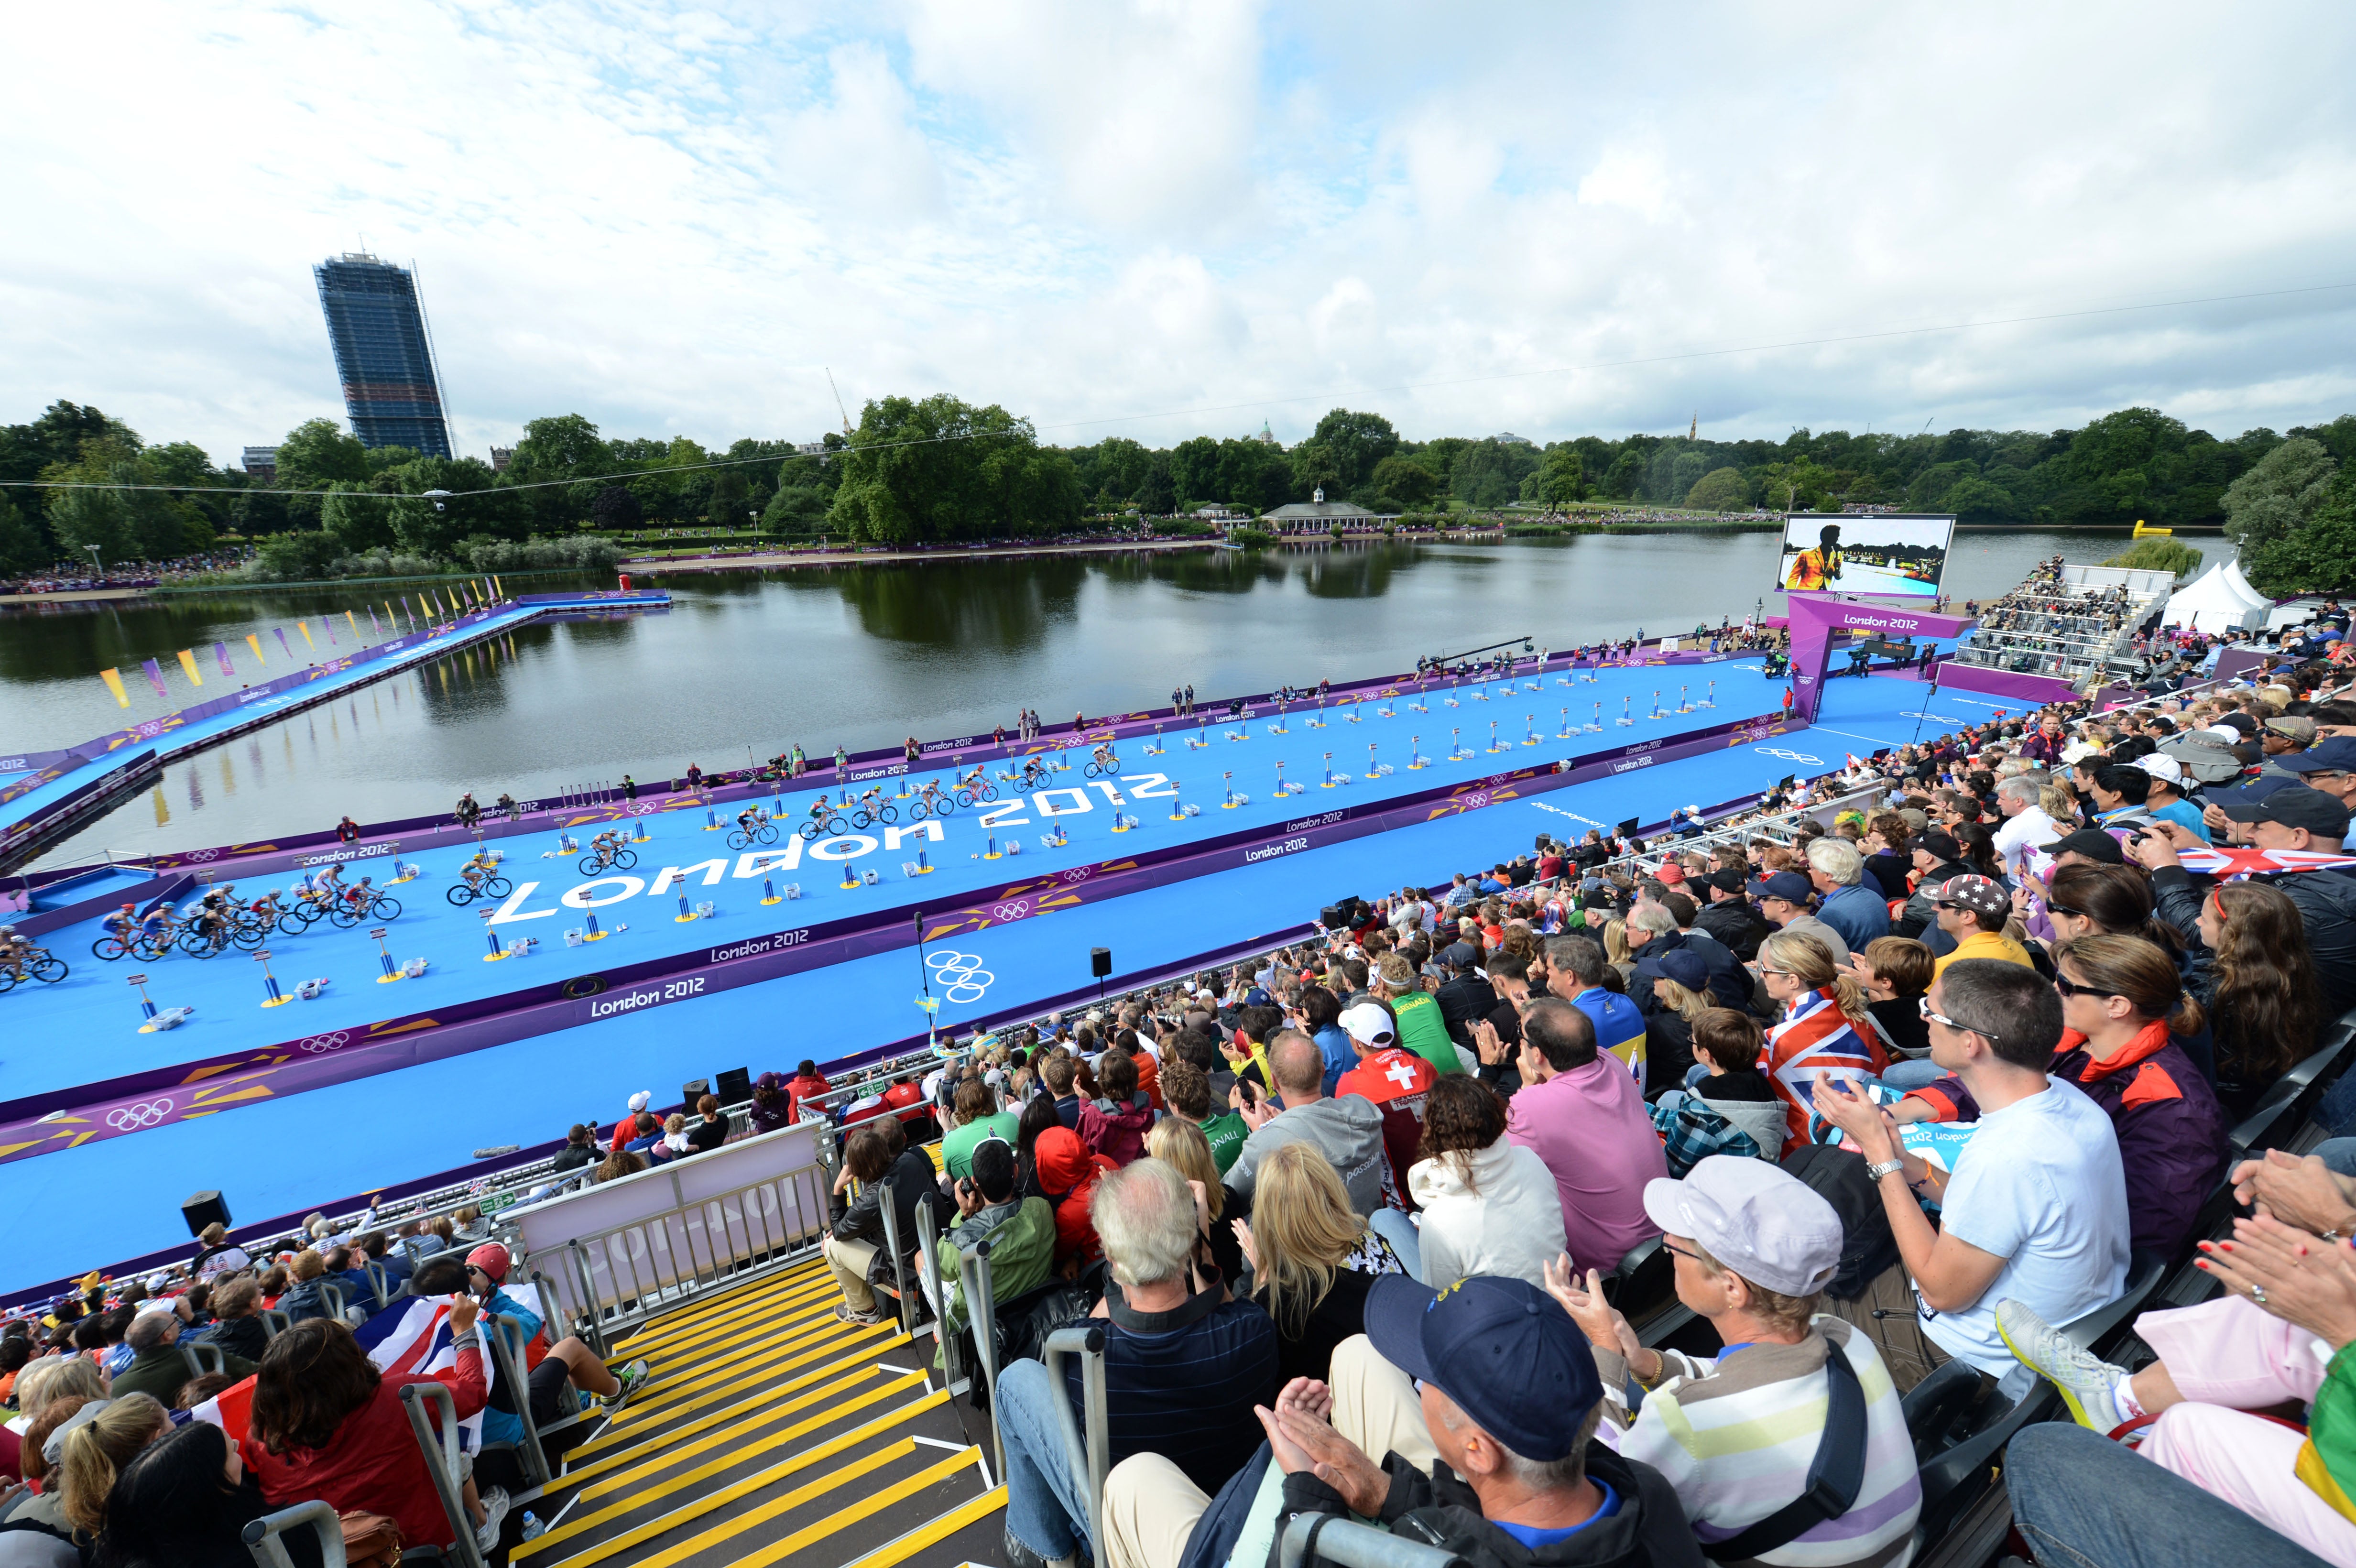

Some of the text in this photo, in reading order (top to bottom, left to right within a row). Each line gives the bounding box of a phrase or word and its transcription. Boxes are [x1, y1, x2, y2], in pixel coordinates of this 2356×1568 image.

[1844, 614, 1918, 630] London 2012
[240, 691, 259, 702] London
[1215, 714, 1240, 723] London
[923, 738, 973, 752] London 2012
[1626, 740, 1662, 755] London 2012
[1614, 756, 1653, 772] London 2012
[851, 769, 886, 781] London
[1287, 811, 1342, 832] London 2012
[1531, 802, 1606, 828] London 2012
[1246, 838, 1307, 861] London 2012
[711, 930, 809, 963] London 2012
[591, 978, 705, 1017] London 2012
[1395, 997, 1432, 1015] GRENADA
[1902, 1131, 1934, 1144] 2012
